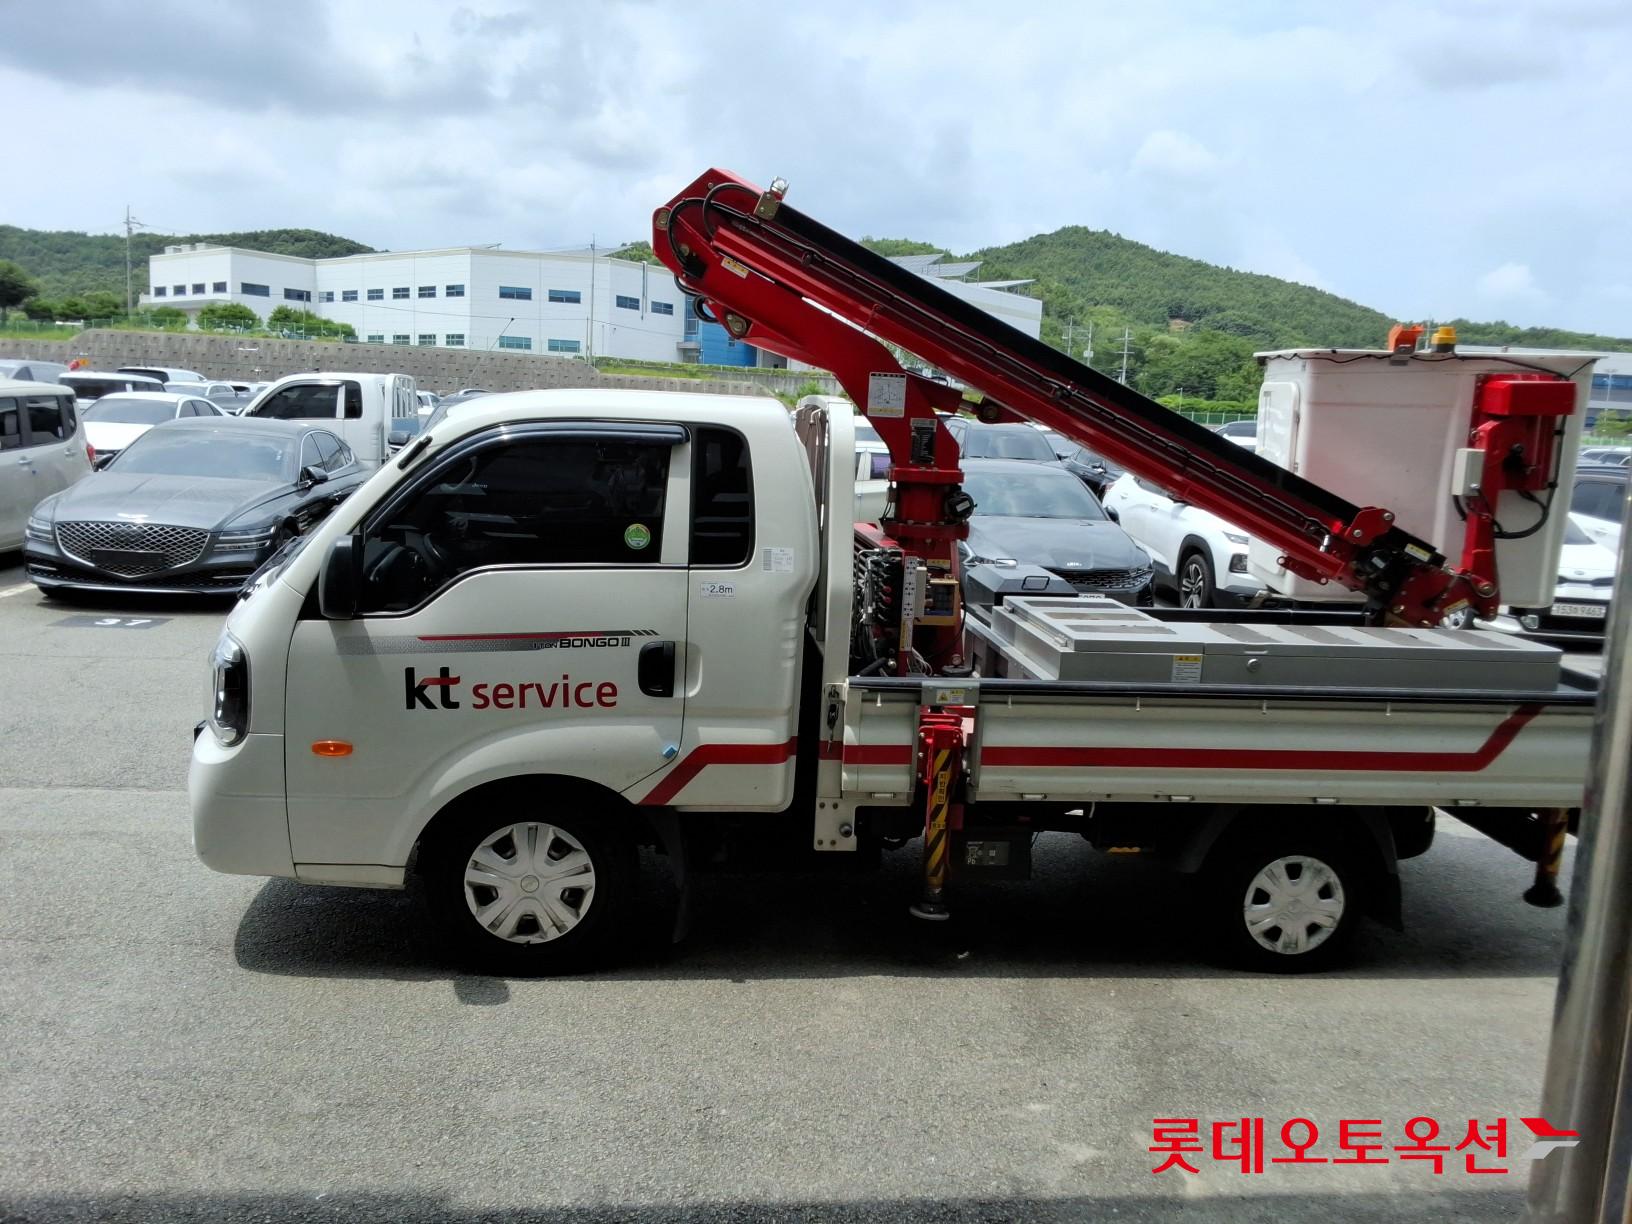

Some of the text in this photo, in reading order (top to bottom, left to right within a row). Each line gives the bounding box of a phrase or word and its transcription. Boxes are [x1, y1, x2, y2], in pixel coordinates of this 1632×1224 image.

[709, 584, 733, 594] 2.8m
[559, 637, 619, 649] BONGO
[404, 666, 619, 710] kt service
